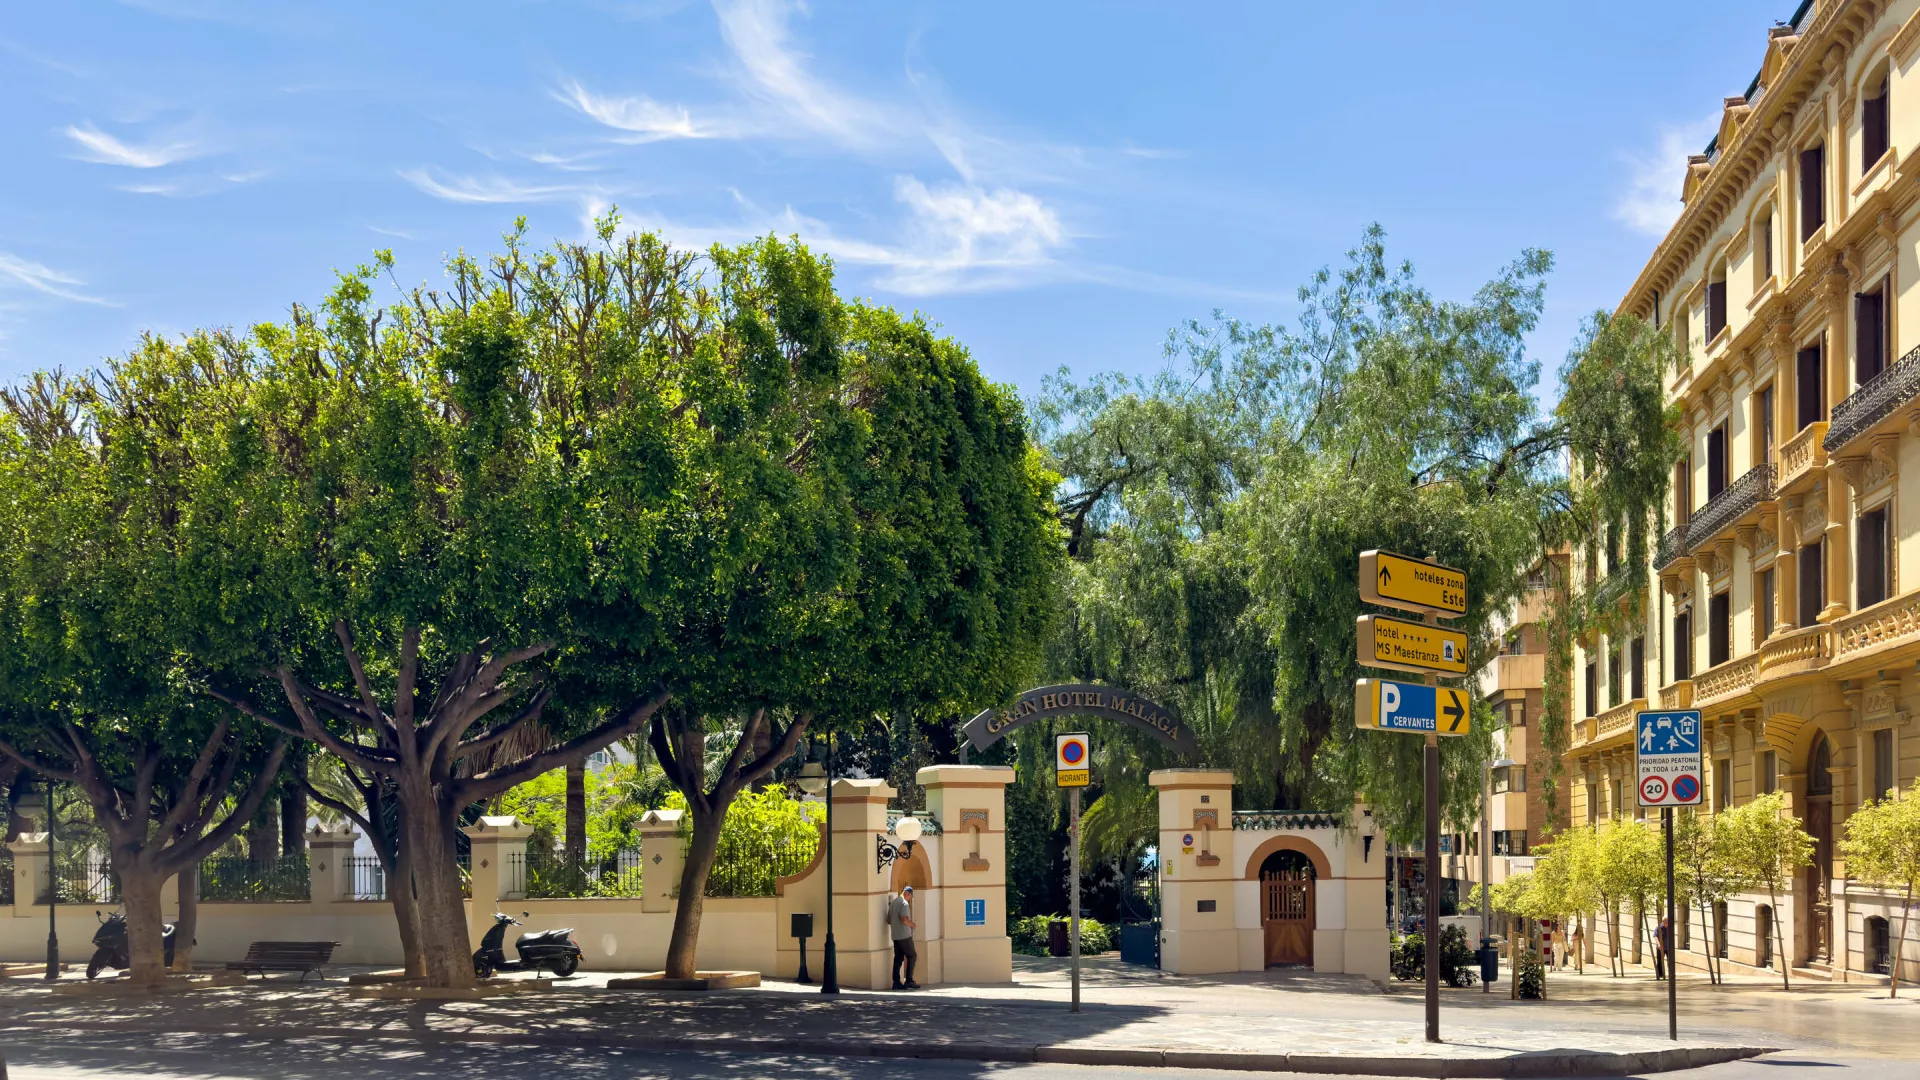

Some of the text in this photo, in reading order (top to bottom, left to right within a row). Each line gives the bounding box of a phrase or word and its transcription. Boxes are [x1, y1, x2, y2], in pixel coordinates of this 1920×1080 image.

[1414, 568, 1464, 589] hoteles zona
[1443, 590, 1464, 607] Este
[1376, 625, 1399, 639] Hotel
[1376, 642, 1440, 662] MS Maestranza
[1380, 682, 1401, 726] P
[987, 697, 1038, 733] GRAN
[1042, 691, 1106, 709] HOTEL
[1393, 716, 1435, 729] CERVANTES
[1059, 774, 1088, 782] HIDRANTE
[1646, 784, 1663, 794] 20
[970, 901, 981, 914] H
